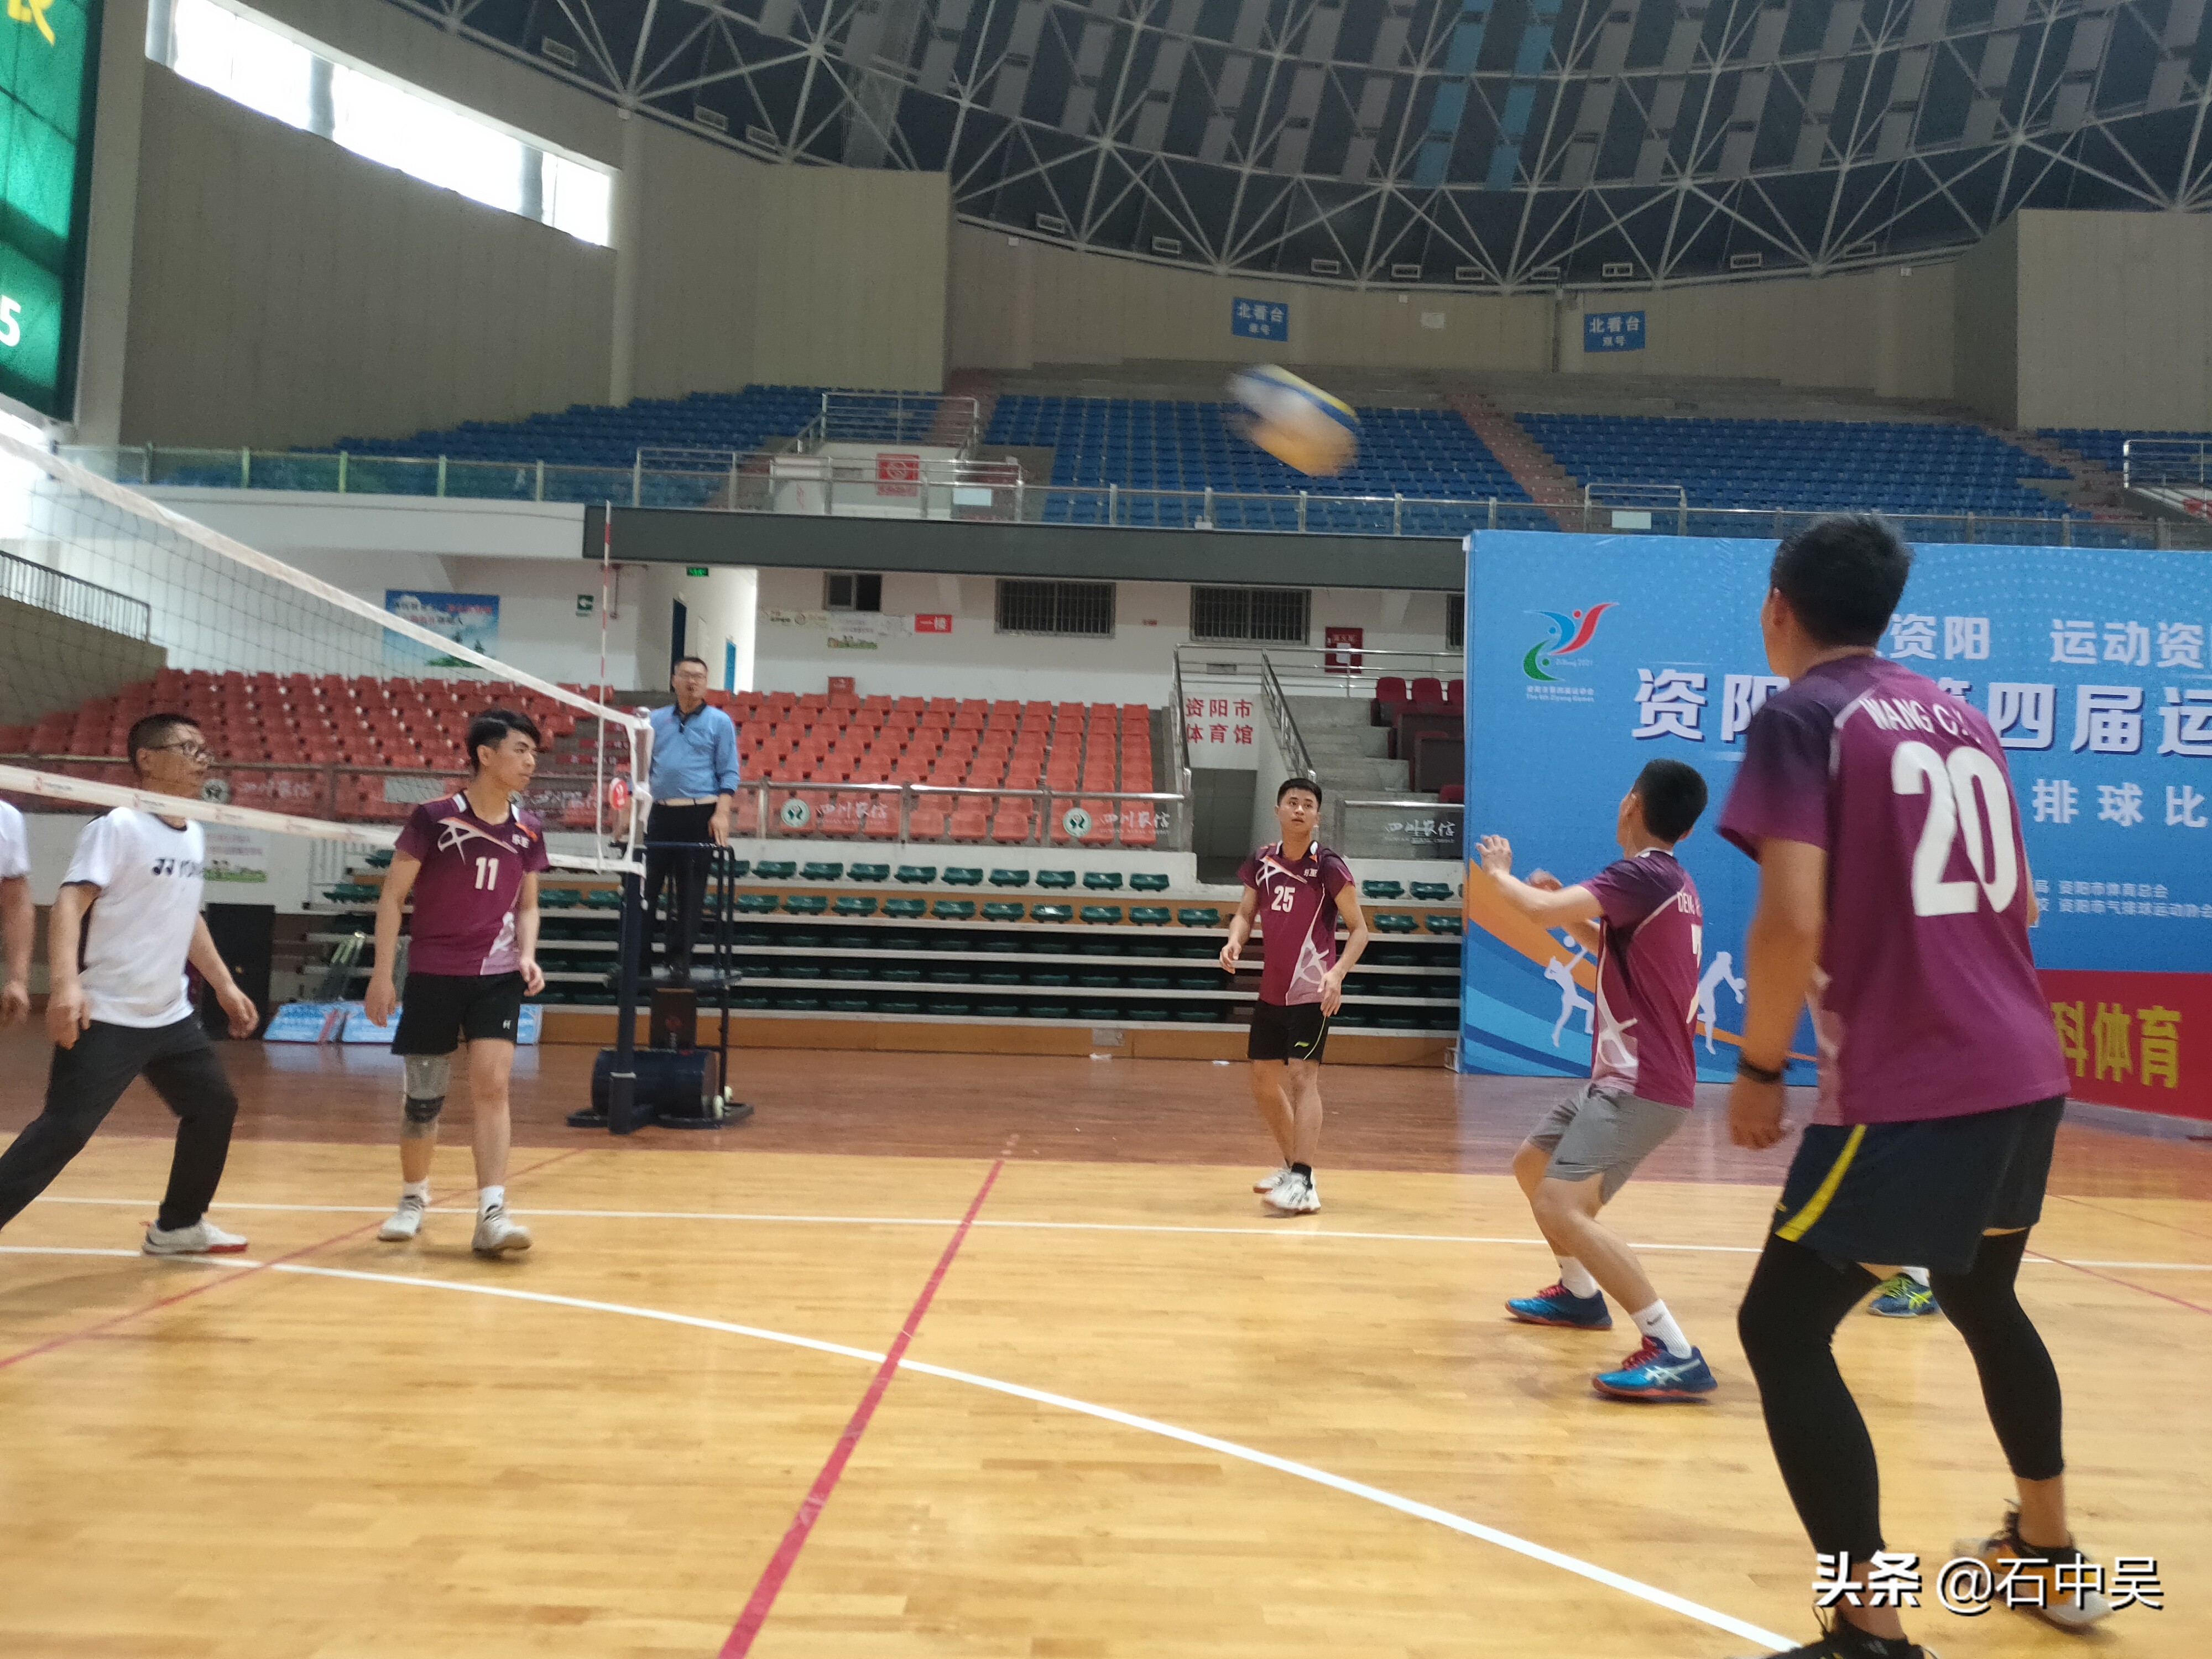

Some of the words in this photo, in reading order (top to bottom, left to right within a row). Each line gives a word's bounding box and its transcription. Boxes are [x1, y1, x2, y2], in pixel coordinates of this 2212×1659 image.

[0, 295, 21, 347] 5
[1238, 302, 1284, 324] 北看台
[1589, 316, 1640, 333] 北看台
[2049, 619, 2212, 669] 运动资
[1185, 698, 1253, 718] 资阳市
[1858, 697, 1934, 734] WANG
[1186, 723, 1253, 744] 体育馆
[2031, 779, 2208, 827] 排球比
[1891, 740, 2017, 916] 20
[475, 857, 498, 891] 11
[1271, 885, 1295, 912] 25
[2051, 1001, 2182, 1089] 科体育
